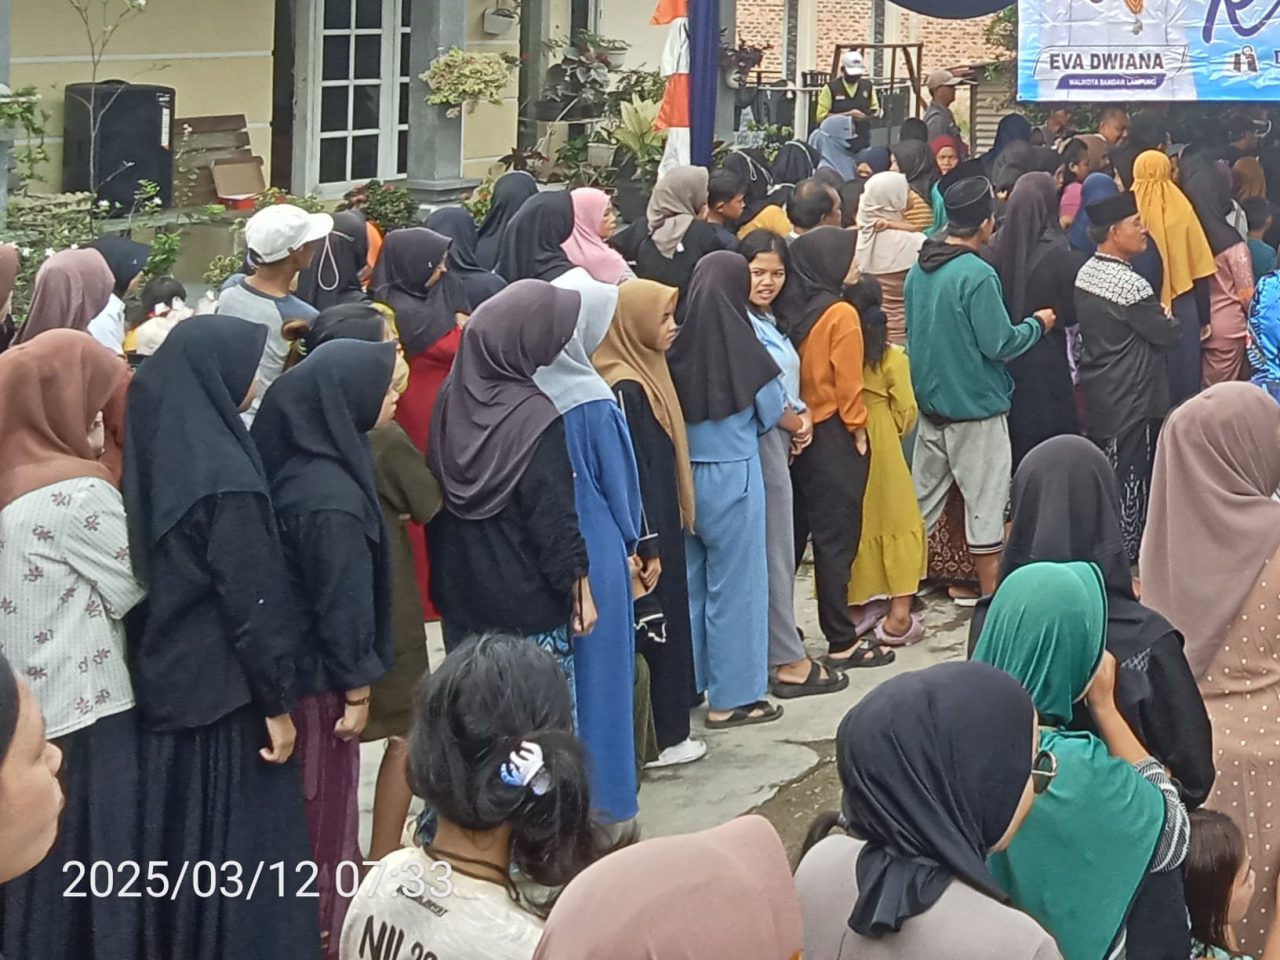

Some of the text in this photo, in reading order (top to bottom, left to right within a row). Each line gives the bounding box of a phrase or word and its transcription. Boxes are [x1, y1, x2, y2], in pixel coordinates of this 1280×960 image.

[1049, 53, 1164, 70] EVA DWIANA
[1099, 78, 1126, 86] BANDAR
[1126, 77, 1157, 86] LAMPUNG
